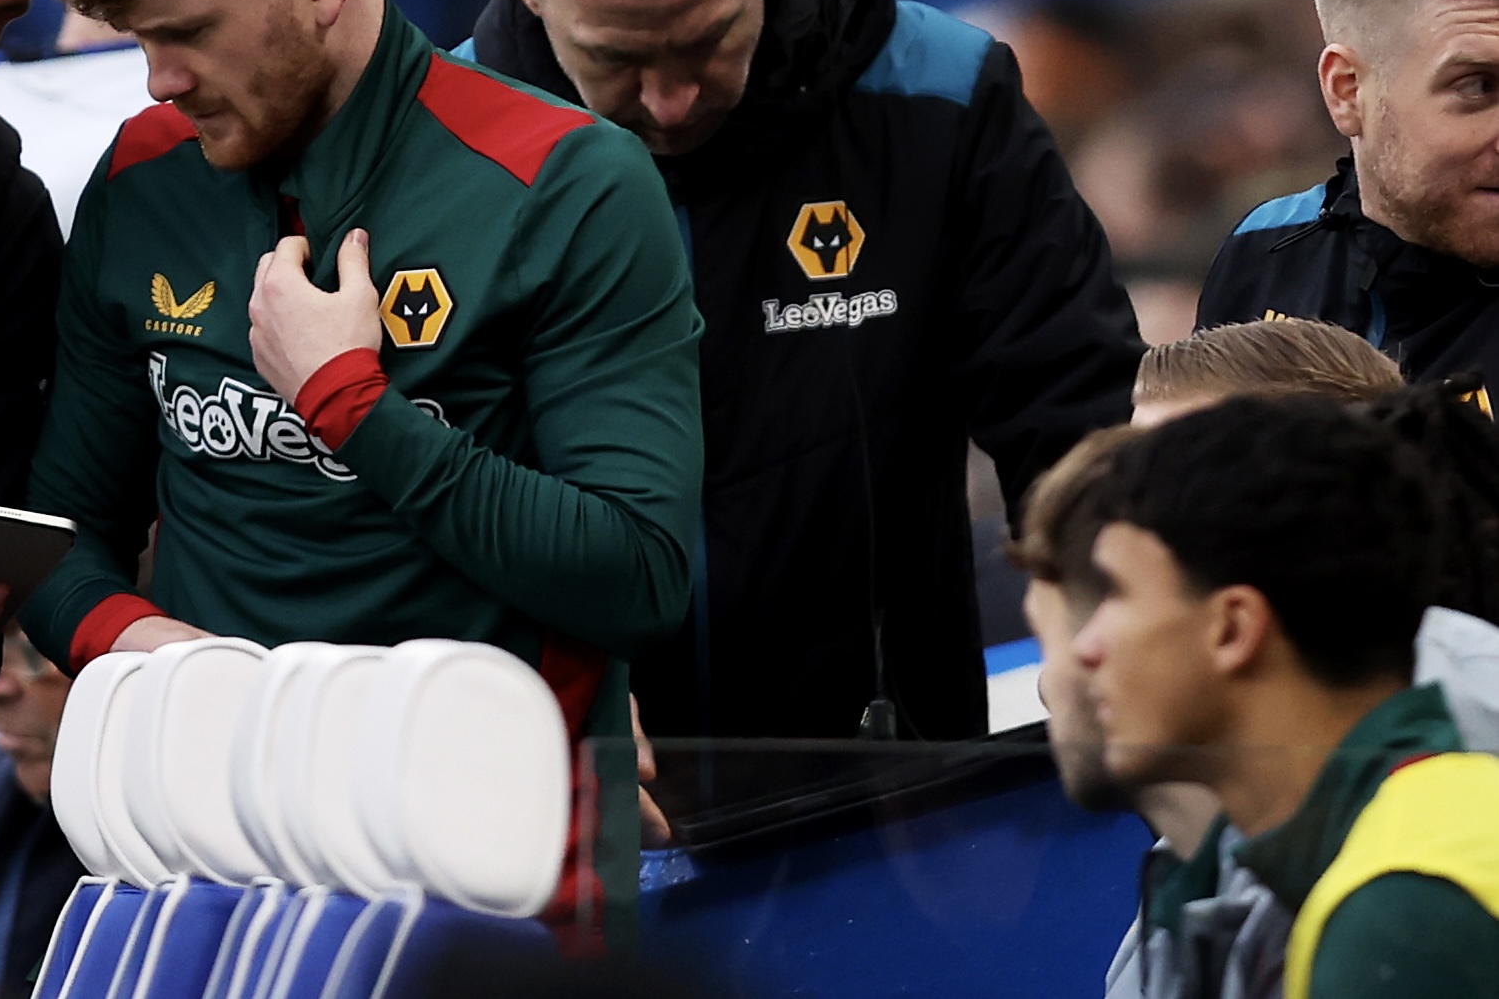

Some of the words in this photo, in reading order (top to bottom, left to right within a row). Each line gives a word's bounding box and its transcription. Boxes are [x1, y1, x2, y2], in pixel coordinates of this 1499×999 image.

[145, 318, 203, 337] CASTORE
[762, 289, 898, 333] LeoVegas
[149, 351, 451, 481] LeoVe
